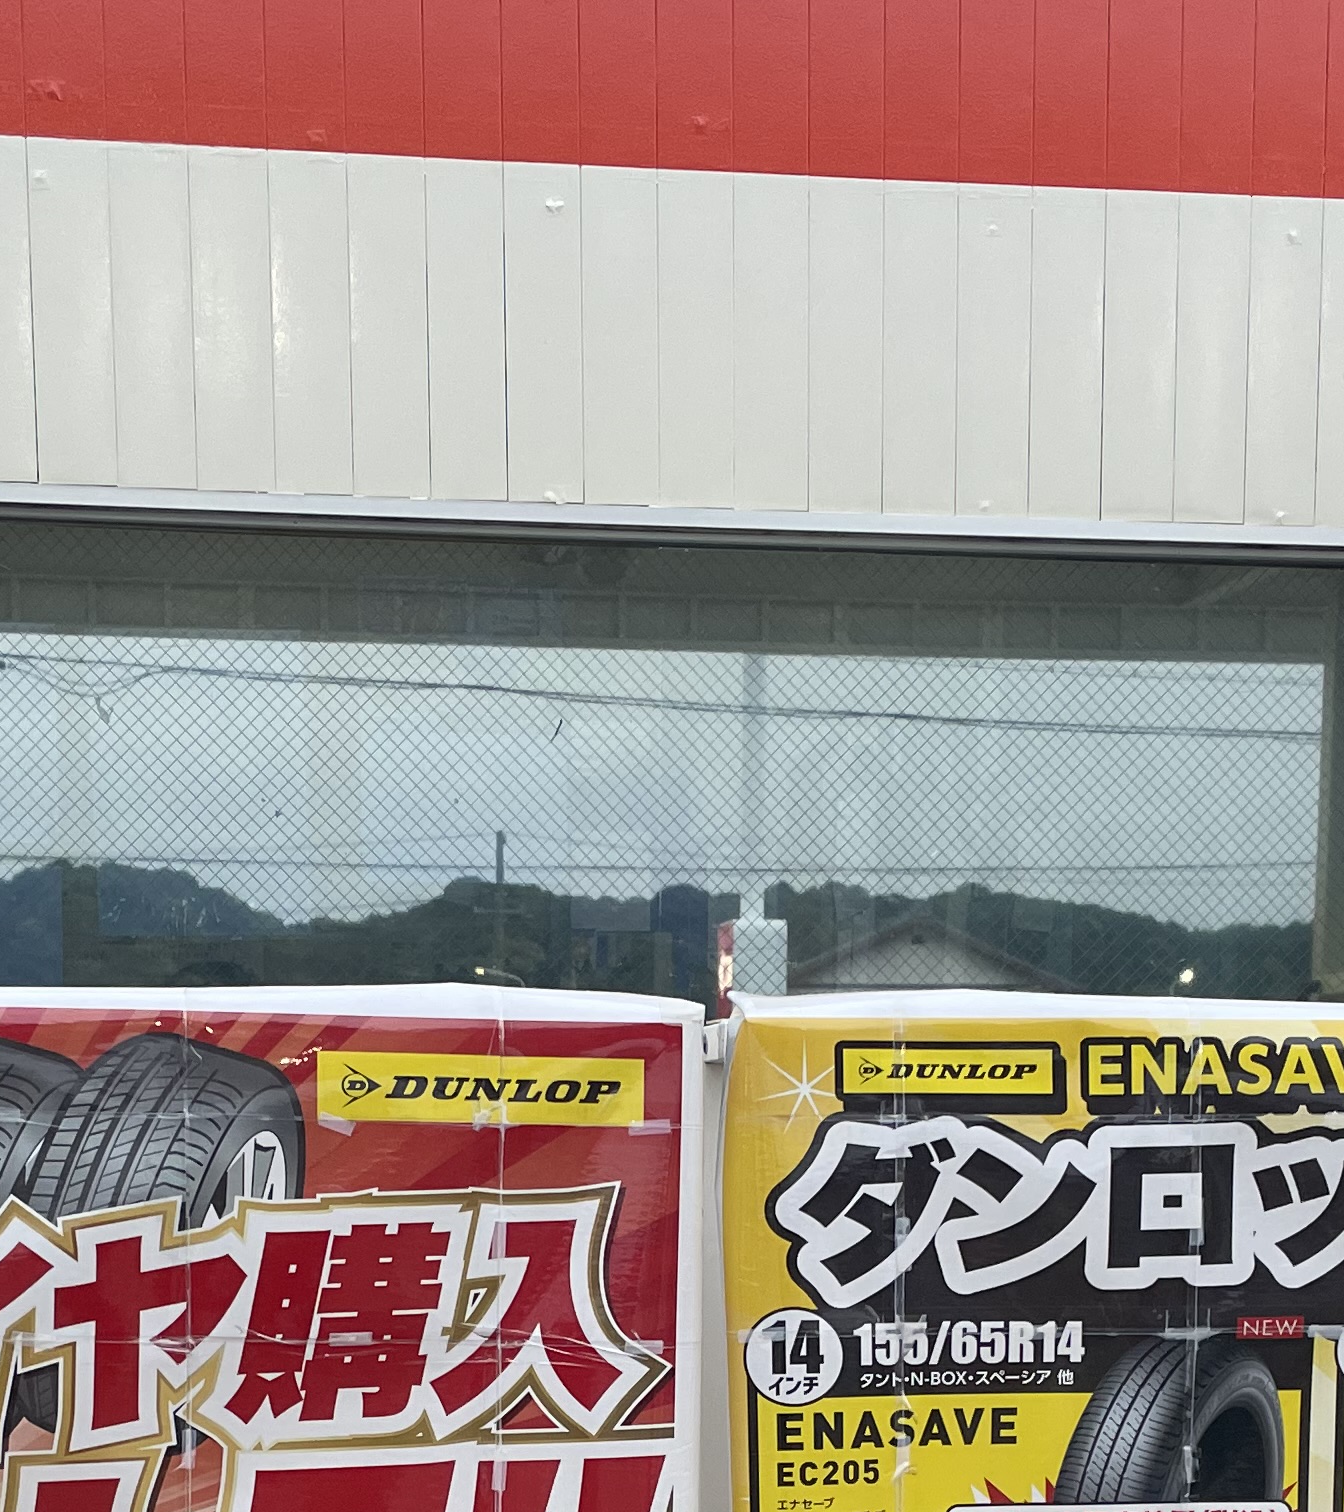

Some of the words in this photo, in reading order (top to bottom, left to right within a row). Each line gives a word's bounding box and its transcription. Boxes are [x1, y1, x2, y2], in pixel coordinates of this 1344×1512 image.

[886, 1061, 1038, 1083] DUNLOP
[384, 1074, 622, 1104] DUNLOP
[1242, 1319, 1297, 1337] NEW
[762, 1320, 824, 1376] 14
[854, 1320, 1085, 1365] 155/65R14
[768, 1376, 819, 1397] インチ
[1057, 1369, 1074, 1385] 他
[776, 1407, 1018, 1451] ENASAVE
[776, 1460, 880, 1487] EC205
[777, 1497, 835, 1511] エナセーブ
